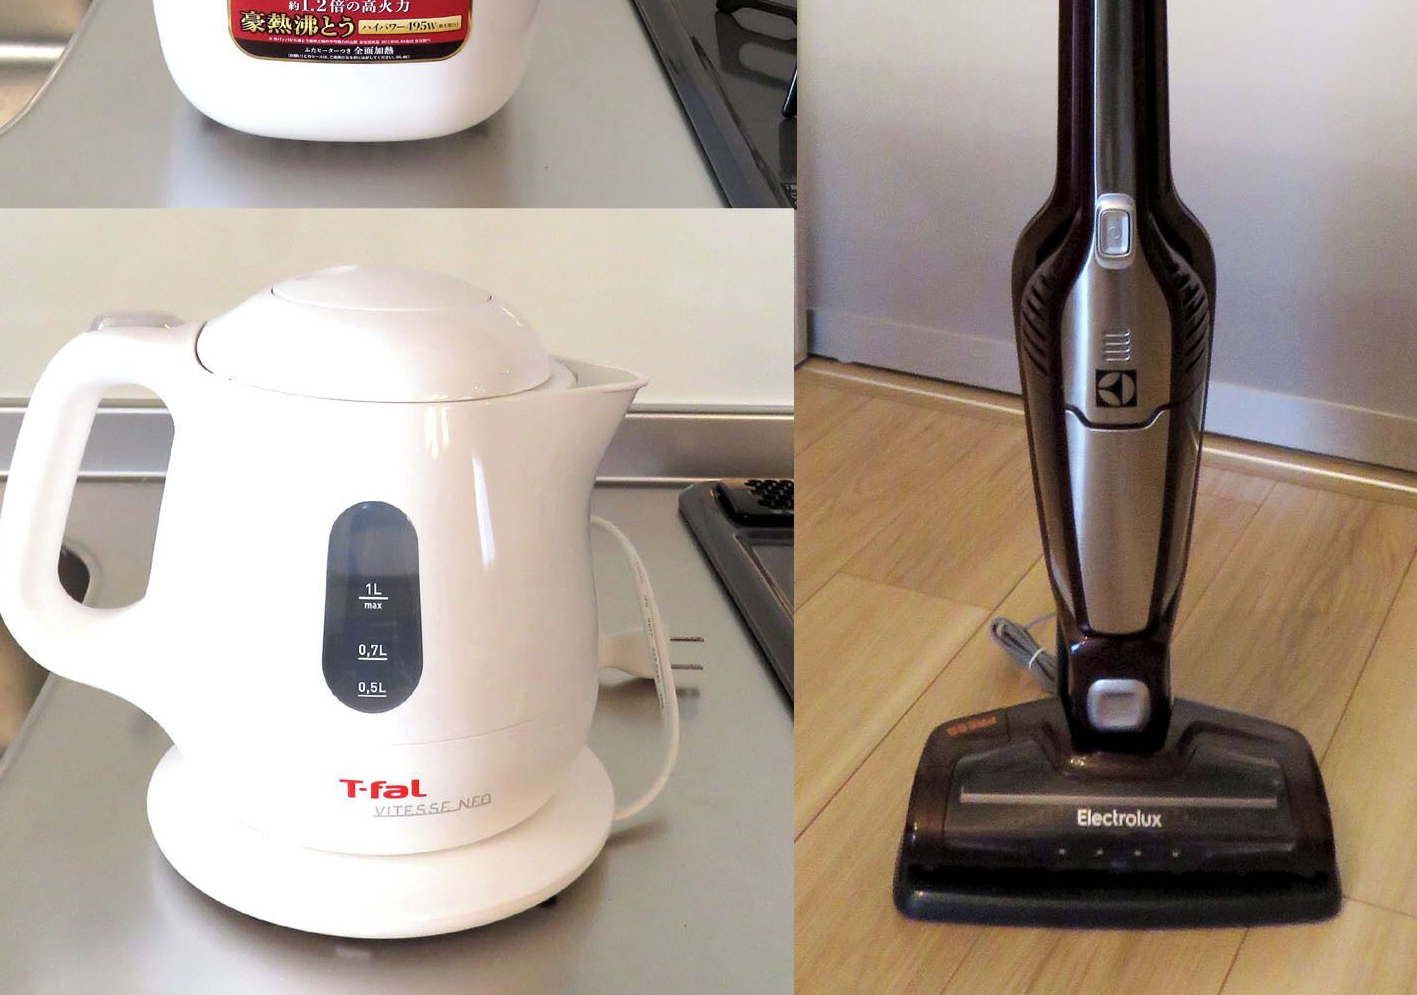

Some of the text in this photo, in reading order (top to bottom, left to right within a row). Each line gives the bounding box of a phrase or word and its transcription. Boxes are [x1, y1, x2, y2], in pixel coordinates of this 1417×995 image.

[364, 601, 383, 610] max
[358, 644, 387, 658] 0,7L
[358, 681, 387, 695] 0,5L
[373, 793, 492, 818] VITESSE NEO
[1077, 808, 1163, 828] Electrolux
